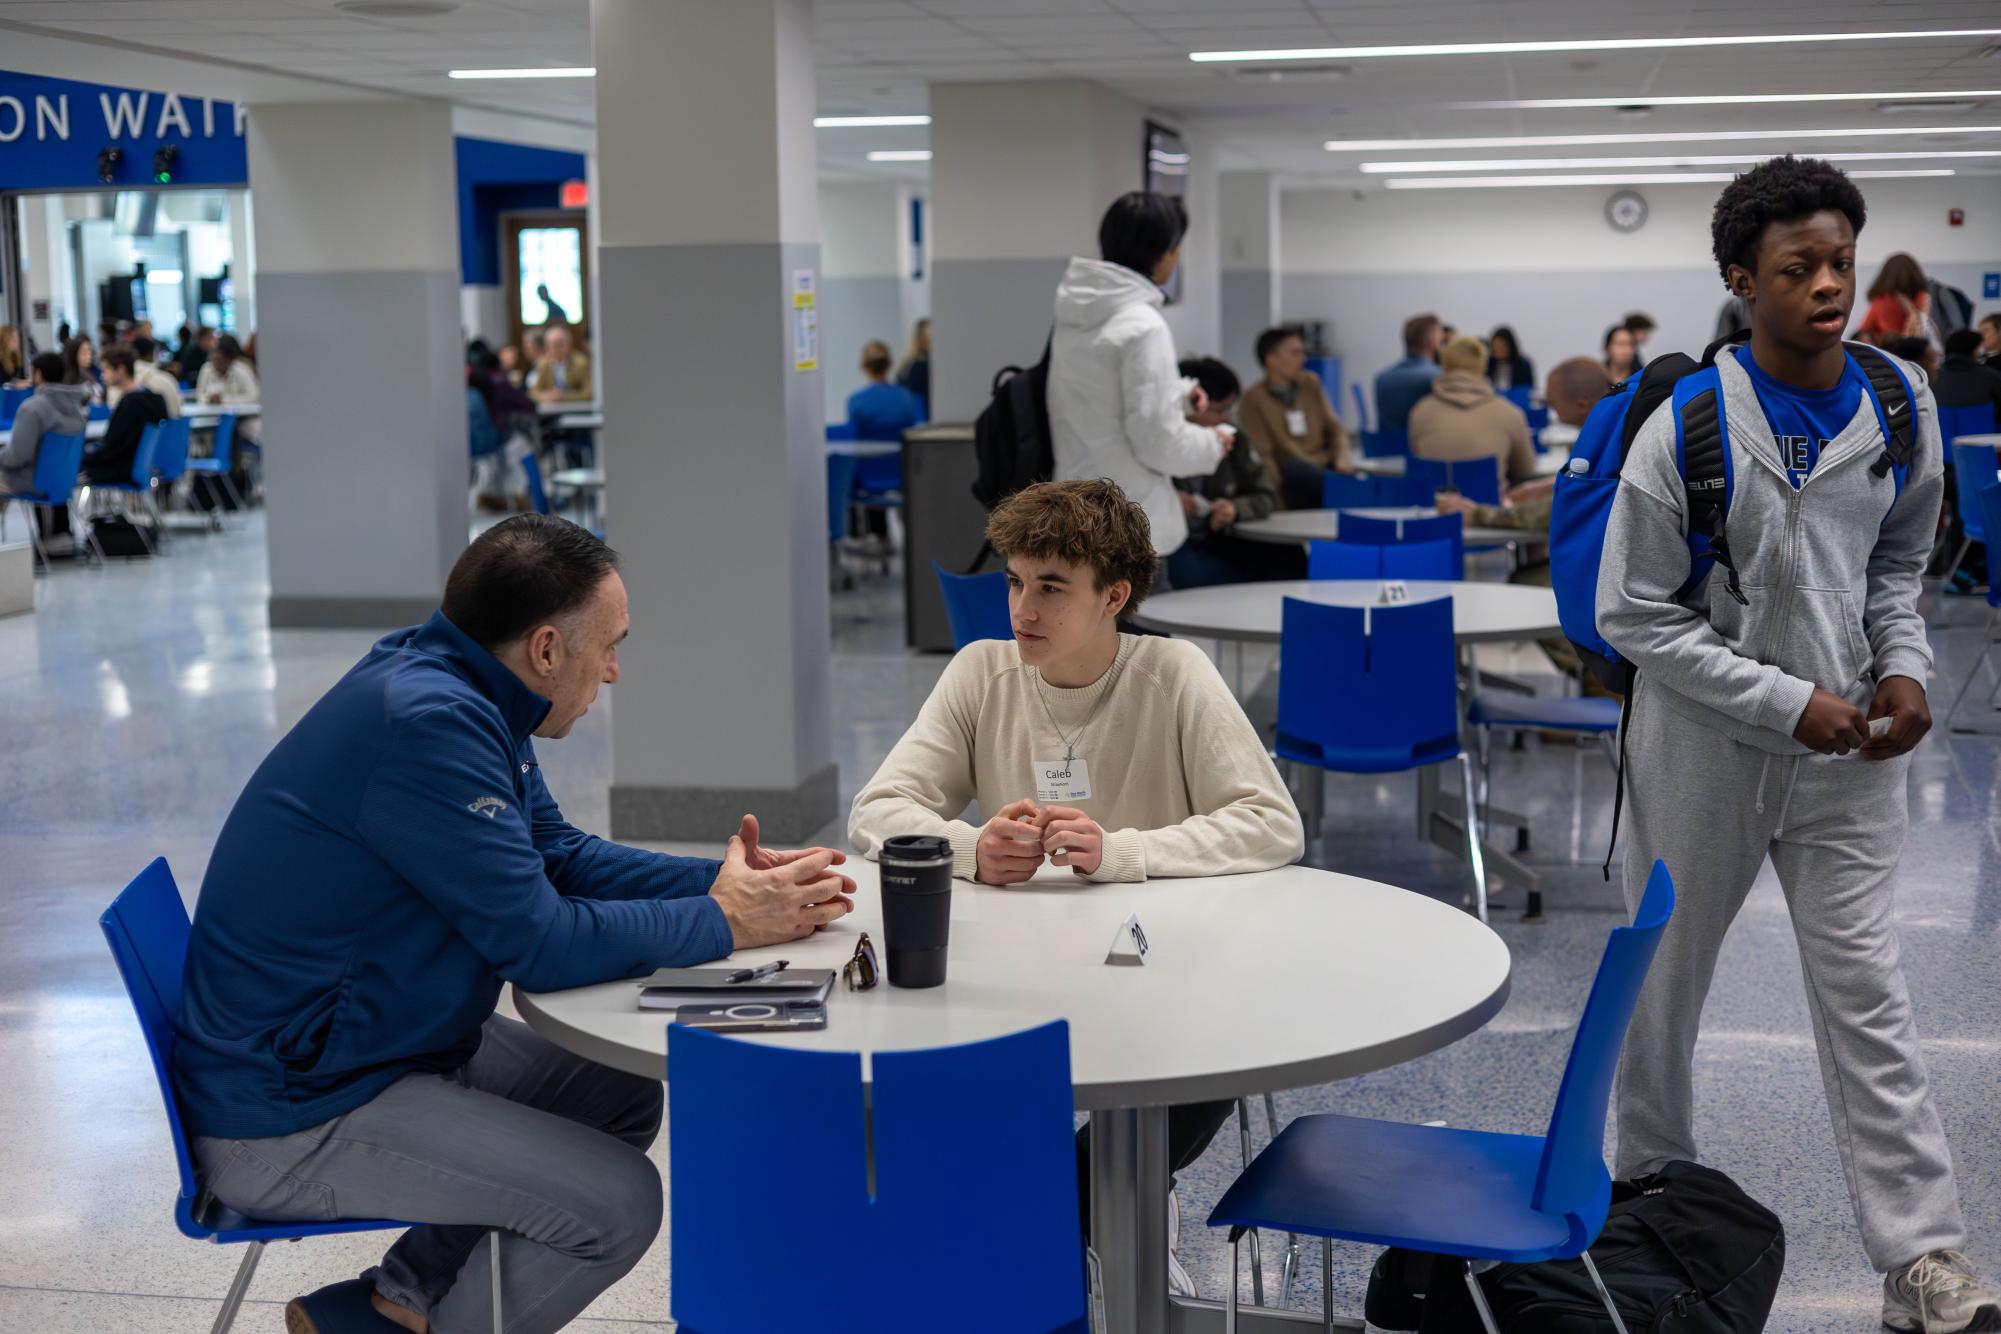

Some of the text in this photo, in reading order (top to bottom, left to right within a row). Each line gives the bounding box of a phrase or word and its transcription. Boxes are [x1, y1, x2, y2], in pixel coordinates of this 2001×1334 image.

[1688, 477, 1725, 490] ELITE
[1045, 769, 1072, 779] Caleb
[1131, 921, 1148, 957] 20
